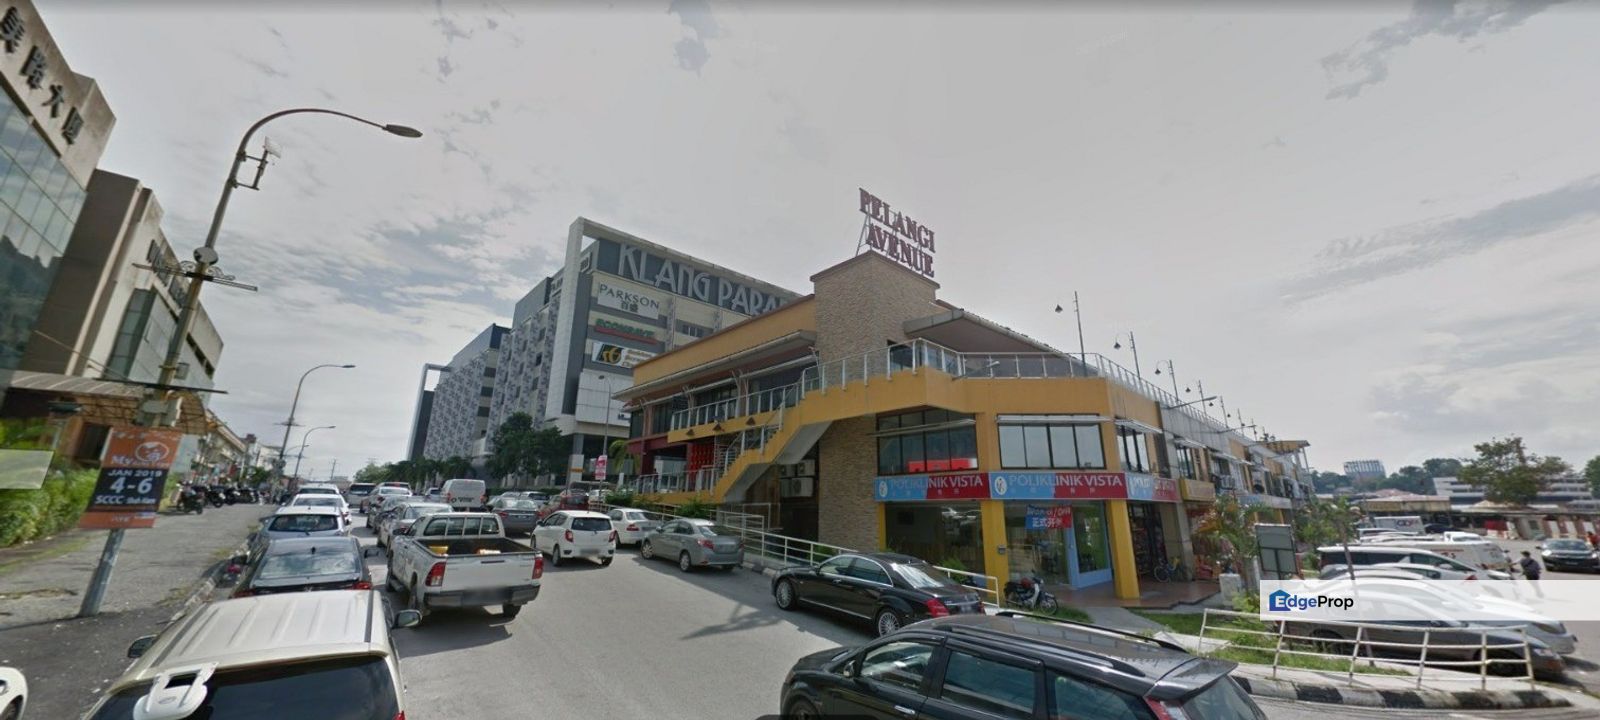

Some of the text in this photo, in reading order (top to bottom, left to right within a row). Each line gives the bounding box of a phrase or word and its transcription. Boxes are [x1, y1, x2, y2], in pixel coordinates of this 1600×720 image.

[859, 187, 936, 253] PELANGI
[866, 223, 934, 278] AVENUE
[618, 243, 711, 303] KLANG
[599, 284, 659, 310] PARKSON
[108, 469, 133, 477] JAN
[949, 475, 984, 487] VISTA
[1008, 475, 1083, 487] POLIKLINIK
[1084, 475, 1123, 487] VISTA
